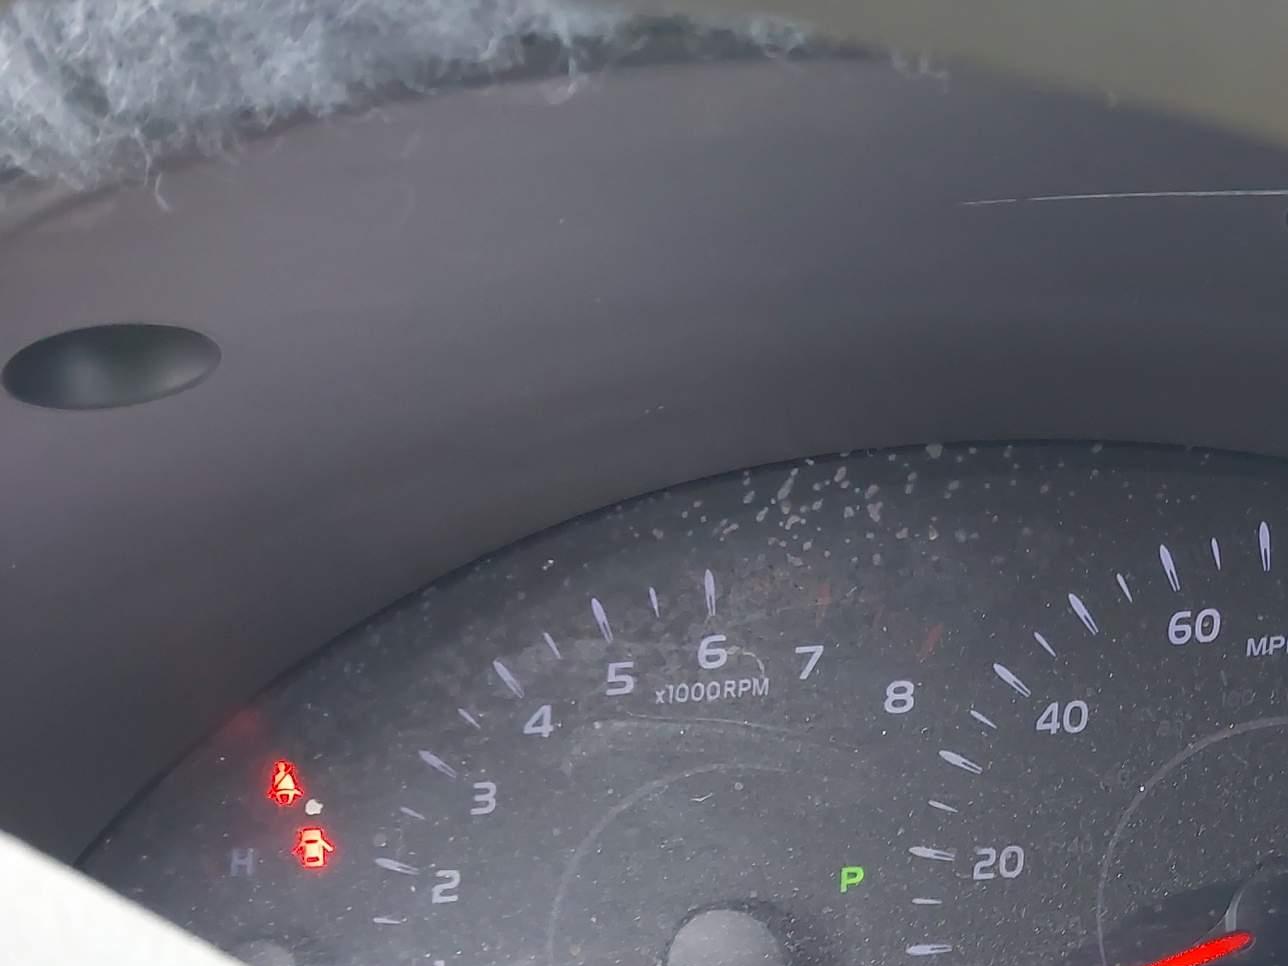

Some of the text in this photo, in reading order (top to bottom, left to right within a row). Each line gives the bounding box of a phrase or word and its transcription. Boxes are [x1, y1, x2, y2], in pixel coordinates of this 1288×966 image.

[1167, 608, 1222, 646] 60
[698, 634, 728, 670] 6
[795, 645, 824, 680] 7
[605, 661, 636, 697] 5
[884, 680, 915, 714] 8
[523, 704, 554, 738] 4
[1035, 699, 1089, 735] 40
[469, 780, 498, 815] 3
[229, 848, 256, 877] H
[839, 866, 864, 893] P
[972, 845, 1025, 881] 20
[430, 869, 462, 905] 2
